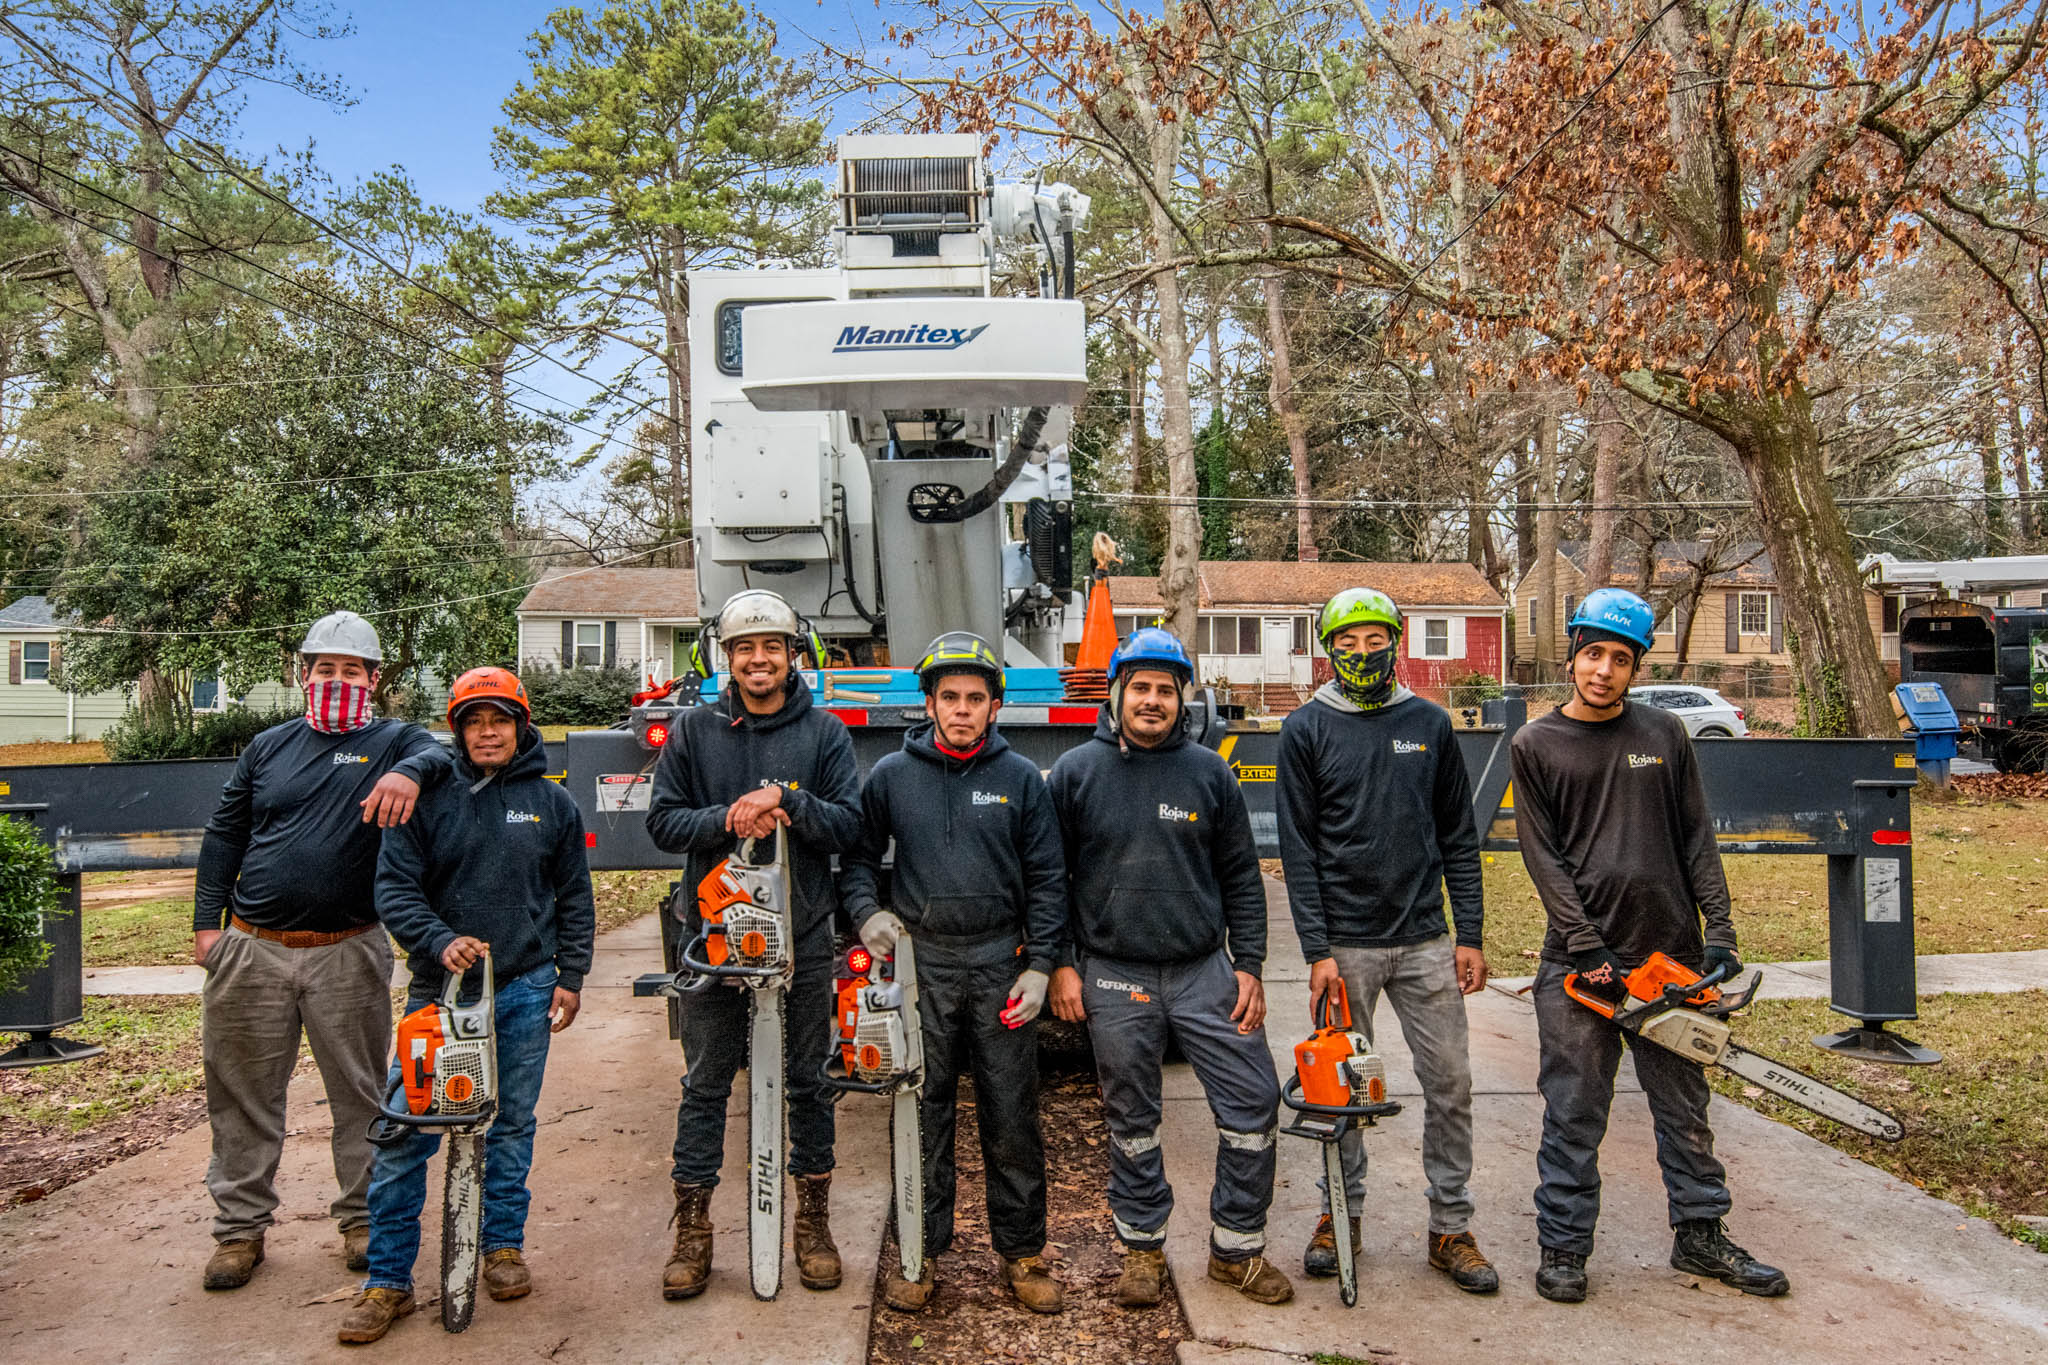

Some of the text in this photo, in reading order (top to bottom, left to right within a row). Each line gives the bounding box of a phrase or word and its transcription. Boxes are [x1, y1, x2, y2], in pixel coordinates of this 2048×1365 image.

[835, 324, 968, 345] Manitex
[1603, 612, 1632, 627] KASK
[468, 681, 500, 690] STIHL
[1393, 740, 1420, 752] Rojas
[333, 752, 361, 764] Rojas
[1628, 753, 1656, 766] Rojas
[972, 791, 1000, 804] Rojas
[506, 810, 535, 822] Rojas
[1159, 803, 1189, 821] Rojas
[1692, 1026, 1717, 1040] STIHL
[1763, 1070, 1809, 1097] STIHL
[758, 1148, 773, 1216] STIHL
[904, 1174, 914, 1215] STIHL
